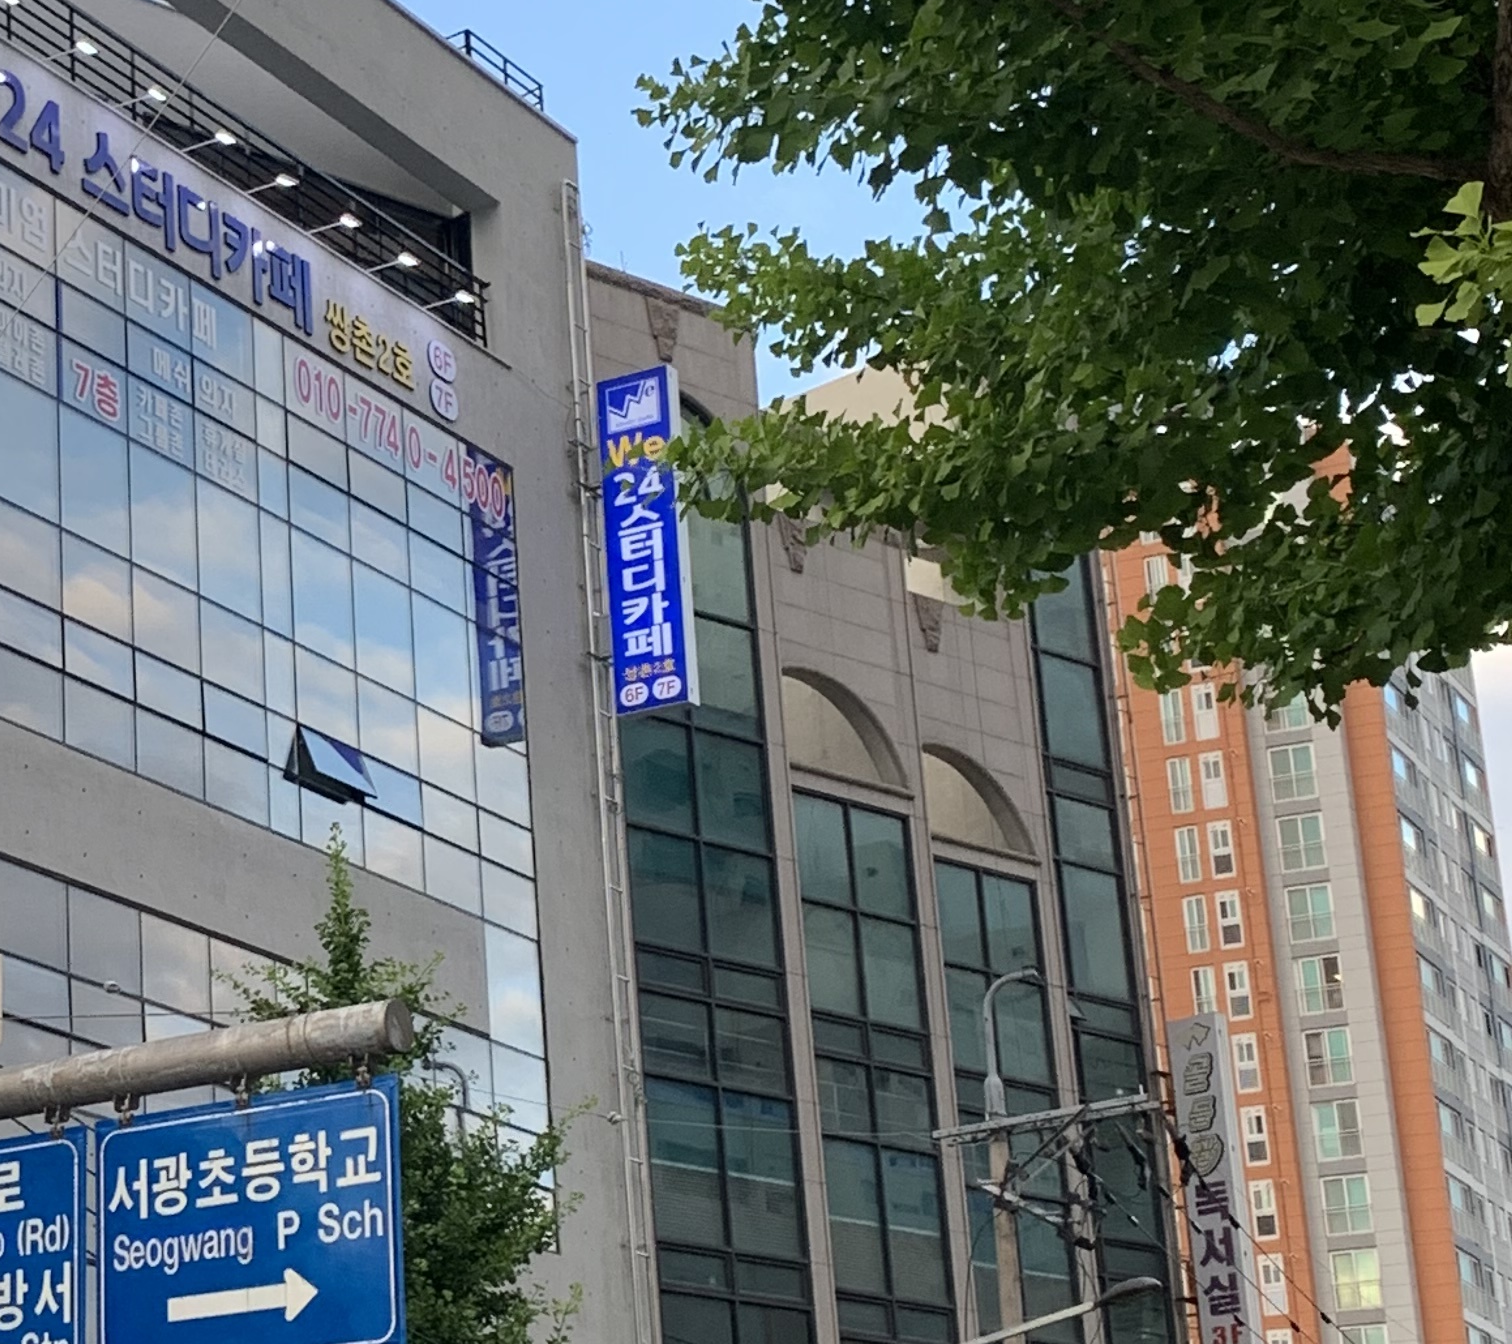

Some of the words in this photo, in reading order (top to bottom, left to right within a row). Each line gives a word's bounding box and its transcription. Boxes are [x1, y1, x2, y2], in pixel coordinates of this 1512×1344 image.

[64, 230, 217, 351] 스터디카페
[82, 130, 314, 337] 스터디카페
[324, 297, 416, 392] 쌍촌2호
[434, 384, 456, 413] 7F
[73, 358, 120, 422] 7층
[152, 346, 190, 394] 메쉬
[199, 374, 236, 421] 의자
[294, 358, 507, 520] 010-7740-4500
[607, 432, 666, 468] We
[613, 466, 664, 506] 24
[617, 504, 674, 658] 스터디카페
[624, 685, 644, 703] 6F
[657, 679, 676, 696] 7F
[108, 1125, 383, 1219] 서광초등학교
[16, 1213, 71, 1260] (Rd)
[113, 1220, 254, 1275] Seogwang
[277, 1209, 299, 1251] P
[317, 1197, 385, 1247] Sch
[1194, 1180, 1242, 1317] 독서실
